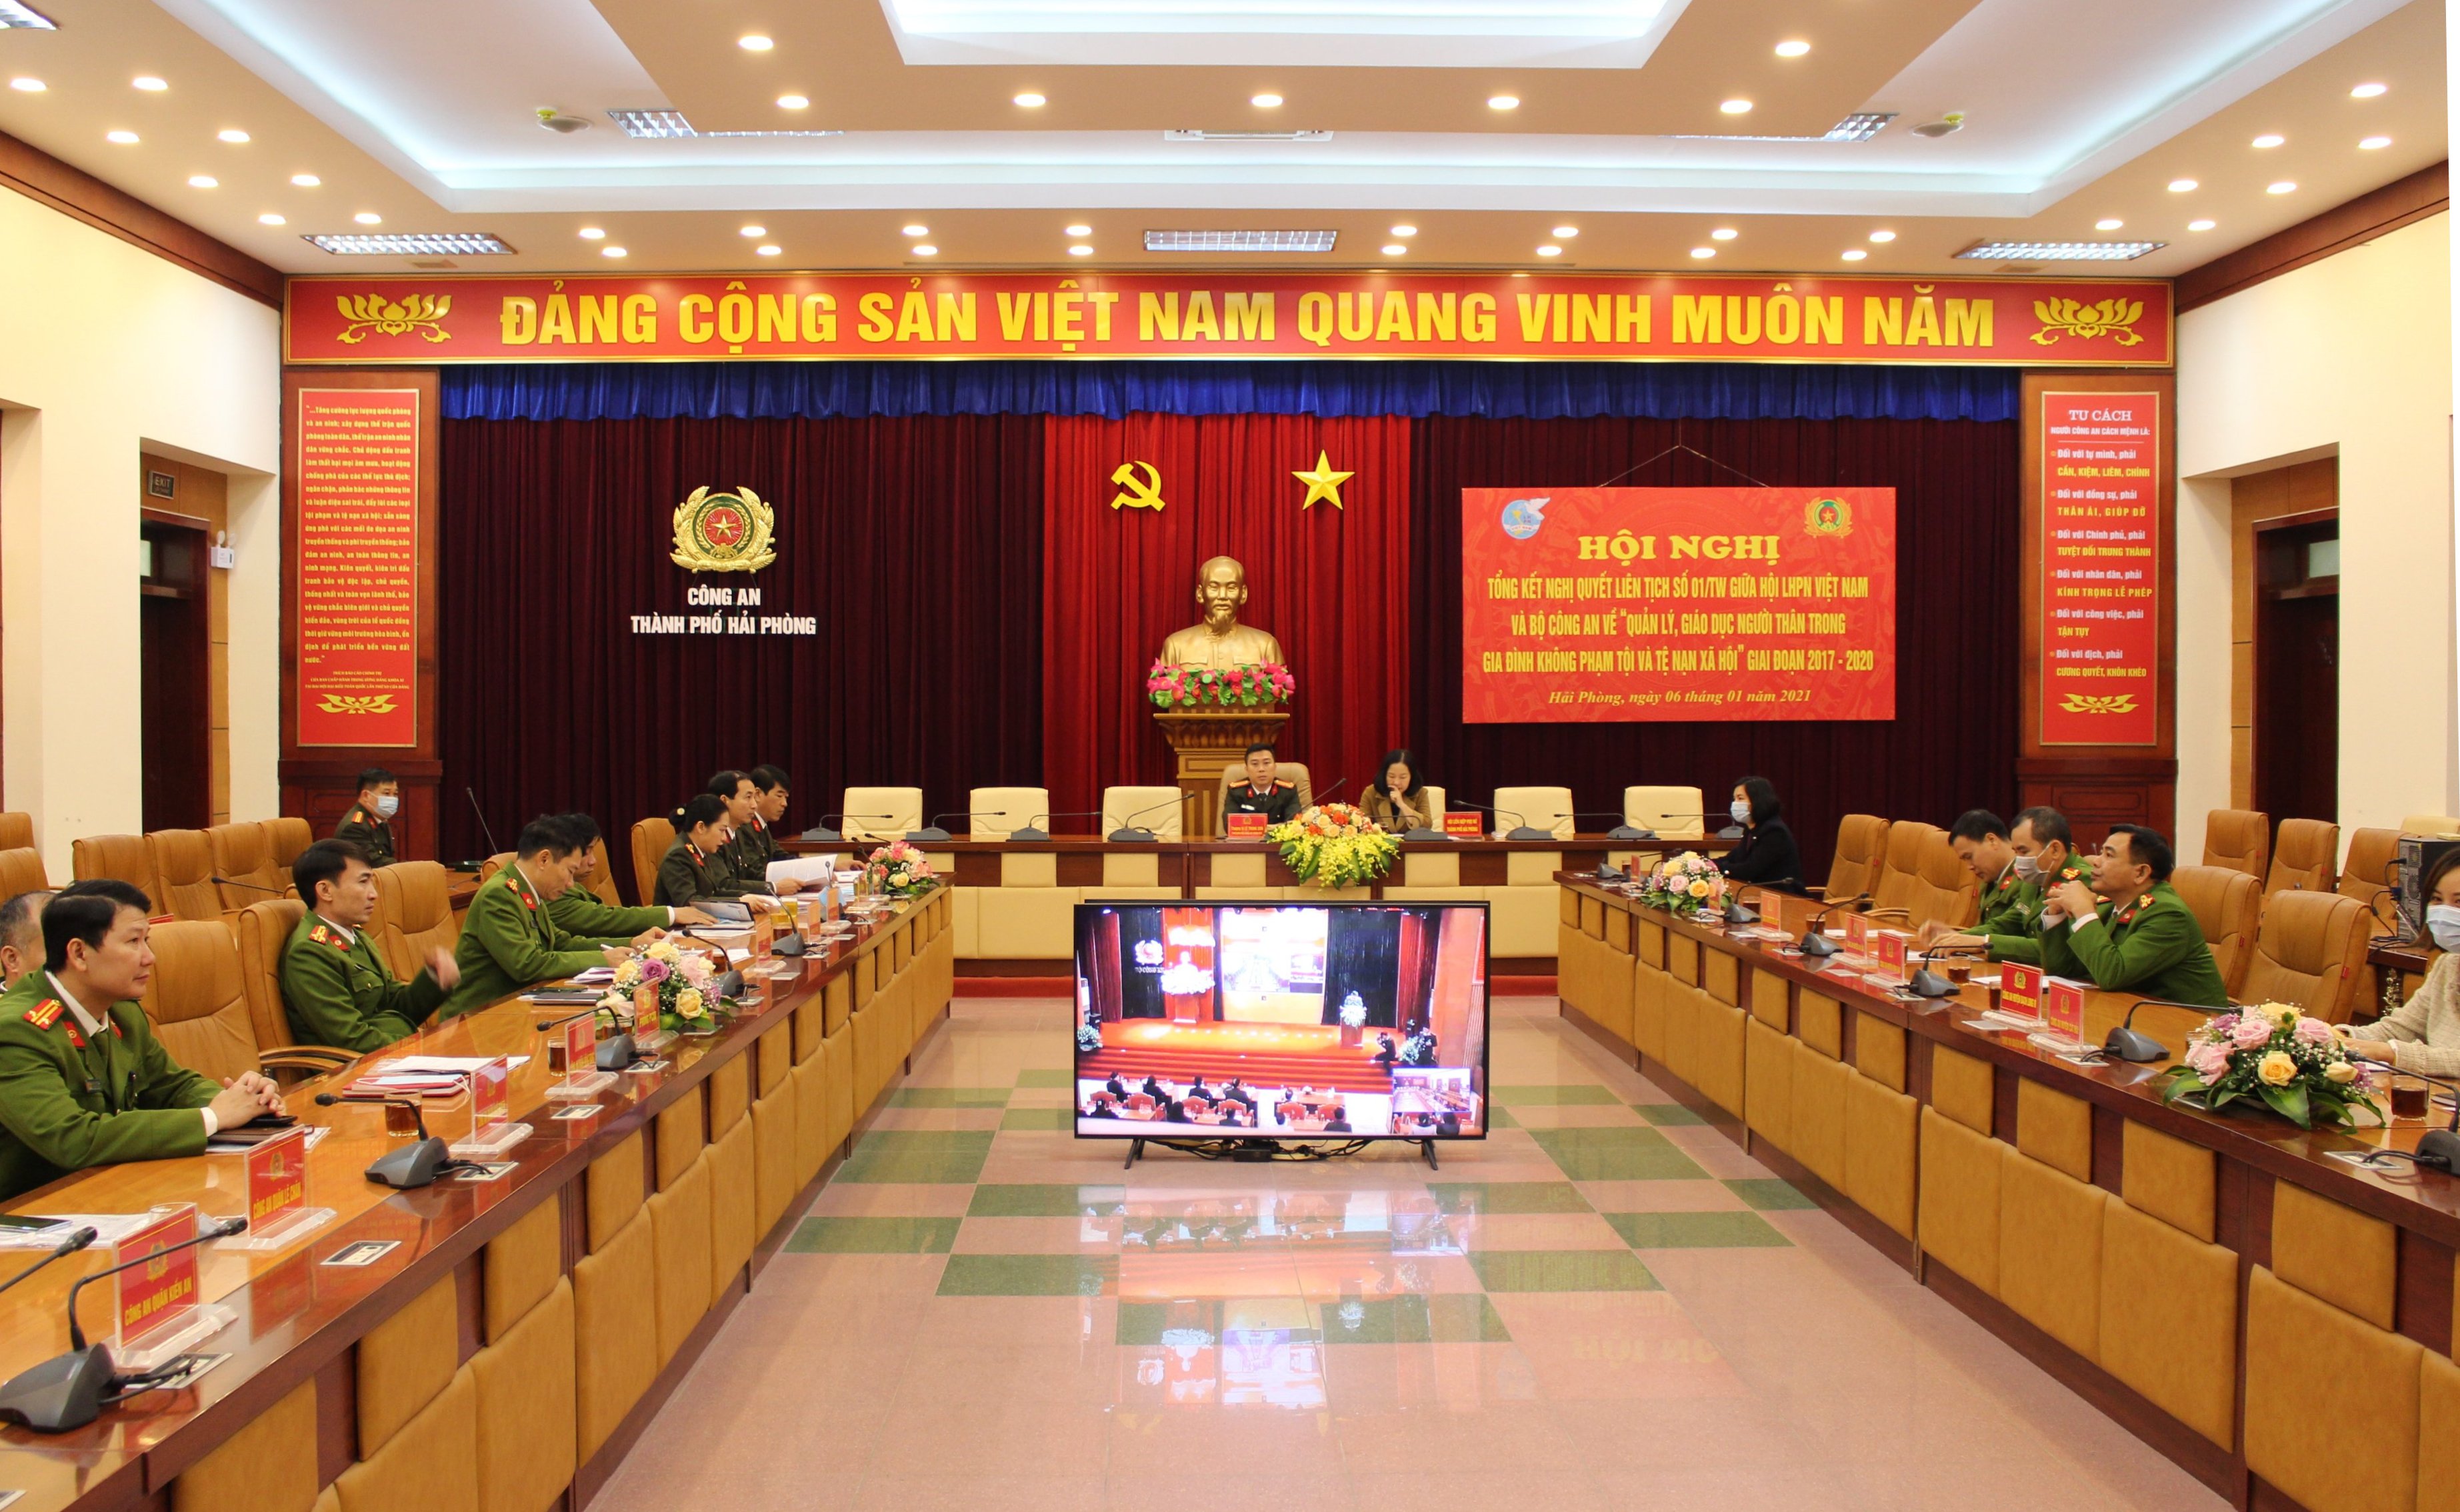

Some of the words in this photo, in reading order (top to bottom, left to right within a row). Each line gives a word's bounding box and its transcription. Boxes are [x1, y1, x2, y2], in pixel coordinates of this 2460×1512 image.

[500, 280, 661, 345] ĐẢNG
[677, 281, 836, 354] CỘNG
[858, 277, 976, 343] SẢN
[1000, 279, 1119, 352] VIỆT
[1139, 291, 1275, 343] NAM
[1298, 289, 1496, 348] QUANG
[1515, 293, 1653, 344] VINH
[1671, 283, 1843, 345] MUÔN
[1864, 283, 1993, 347] NĂM
[2092, 408, 2132, 421] CÁCH
[155, 476, 170, 487] EXIT
[1578, 529, 1656, 566] HỘI
[1669, 535, 1780, 565] NGHỊ
[688, 584, 732, 605] CÔNG
[737, 588, 761, 605] AN
[1487, 569, 1518, 599] TỔNG
[1521, 571, 1543, 599] KẾT
[1545, 577, 1573, 603] NGHỊ
[1577, 571, 1613, 601] QUYẾT
[1615, 573, 1641, 598] LIÊN
[1644, 577, 1669, 603] TỊCH
[1673, 569, 1688, 597] SỐ
[1691, 577, 1727, 598] 01/TW
[1730, 573, 1757, 597] GIỮA
[1760, 572, 1779, 602] HỘI
[1782, 577, 1812, 597] LHPN
[1815, 572, 1839, 602] VIỆT
[1841, 577, 1868, 597] NAM
[631, 612, 685, 633] THÀNH
[689, 609, 722, 634] PHỐ
[728, 610, 755, 634] HẢI
[761, 613, 816, 635] PHÒNG
[1511, 610, 1527, 635] VÀ
[1529, 610, 1545, 640] BỘ
[1548, 610, 1580, 635] CÔNG
[1583, 614, 1600, 635] AN
[1603, 607, 1617, 635] VỀ
[1620, 607, 1658, 637] “QUẢN
[1661, 609, 1678, 637] LÝ,
[1681, 609, 1708, 635] GIÁO
[1711, 613, 1734, 639] DỤC
[1737, 608, 1773, 634] NGƯỜI
[1775, 609, 1805, 634] THÂN
[1808, 613, 1845, 634] TRONG
[1483, 651, 1503, 673] GIA
[1505, 647, 1534, 672] ĐÌNH
[1537, 647, 1577, 672] KHÔNG
[1579, 651, 1613, 676] PHẠM
[1616, 646, 1635, 676] TỘI
[1637, 646, 1653, 671] VÀ
[1655, 646, 1669, 675] TỆ
[1672, 650, 1697, 675] NẠN
[1700, 646, 1716, 671] XÃ
[1719, 644, 1744, 675] HỘI”
[1747, 650, 1770, 671] GIAI
[1773, 649, 1805, 675] ĐOẠN
[1807, 649, 1835, 671] 2017
[1846, 650, 1873, 671] 2020
[1549, 691, 1575, 703] Hải
[1578, 691, 1625, 706] Phòng,
[1629, 691, 1661, 705] ngày
[1665, 691, 1681, 702] 06
[1685, 691, 1723, 705] tháng
[1727, 690, 1742, 702] 01
[1747, 691, 1776, 701] năm
[1779, 690, 1811, 701] 2021
[125, 1304, 142, 1327] CÔNG
[143, 1297, 151, 1317] AN
[152, 1288, 169, 1312] QUẬN
[183, 1276, 193, 1294] AN
